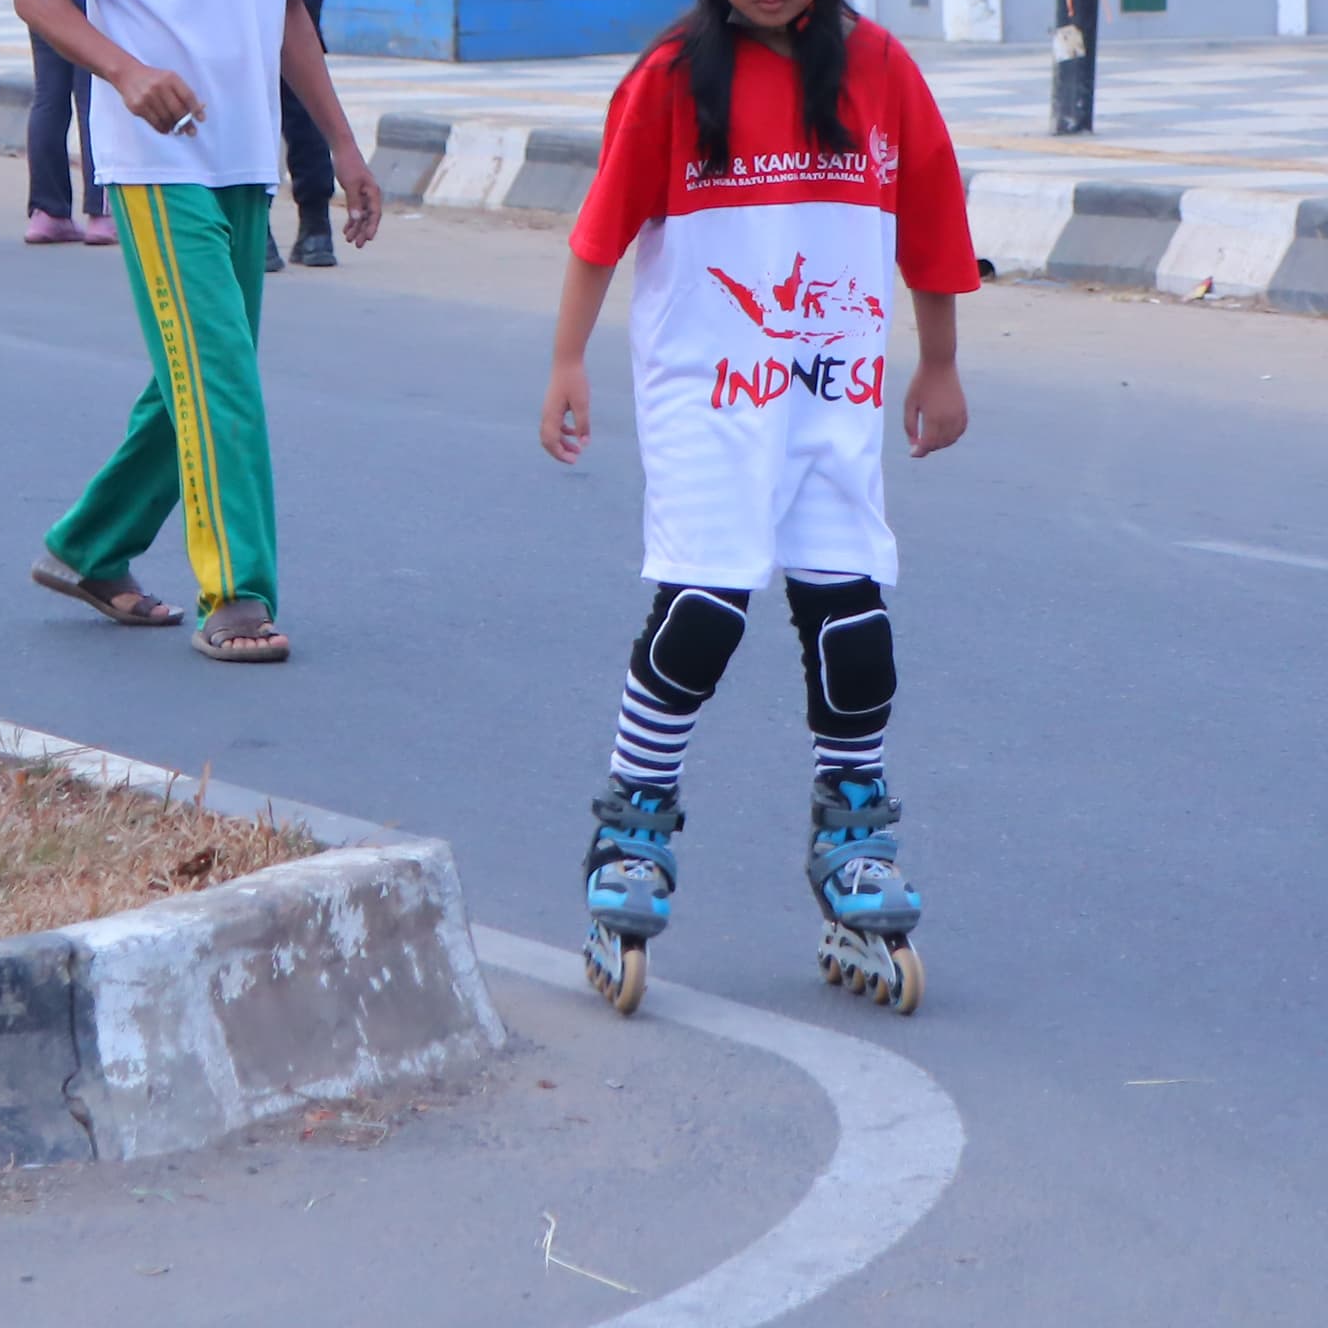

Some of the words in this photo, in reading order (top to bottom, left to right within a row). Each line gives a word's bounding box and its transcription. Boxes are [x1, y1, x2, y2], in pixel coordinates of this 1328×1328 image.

[733, 157, 748, 175] &
[817, 152, 868, 172] SATU
[154, 276, 169, 312] SMP
